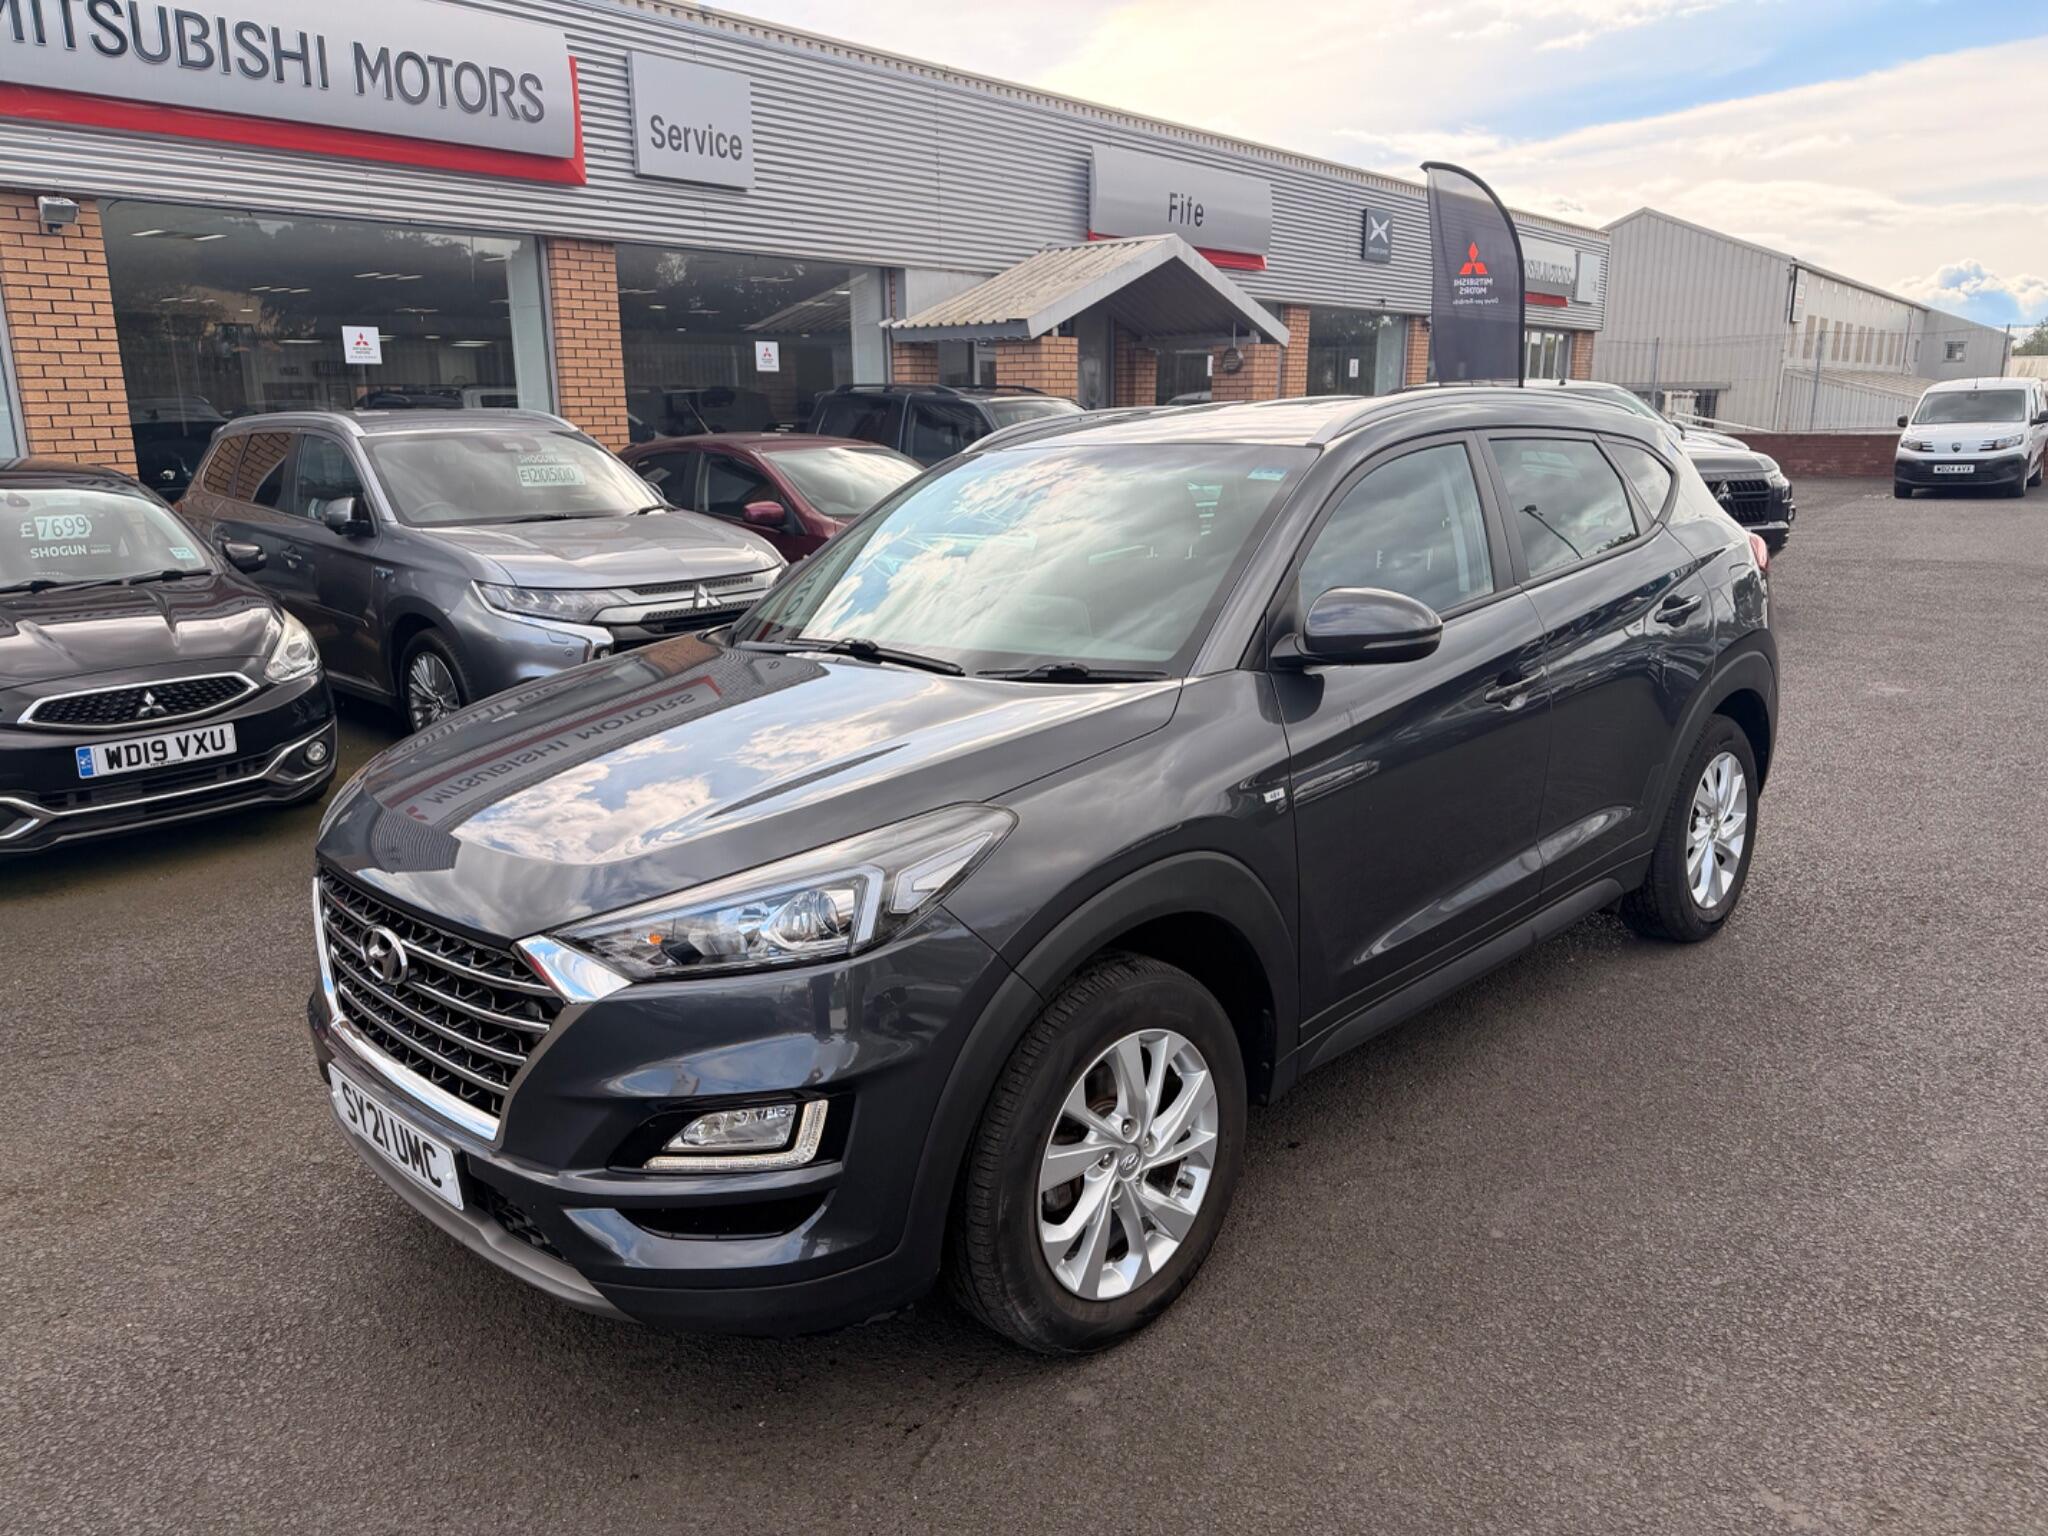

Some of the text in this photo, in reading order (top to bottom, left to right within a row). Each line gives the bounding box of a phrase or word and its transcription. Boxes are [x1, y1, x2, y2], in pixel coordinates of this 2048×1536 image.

[352, 41, 545, 124] MOTORS
[650, 115, 743, 161] Service
[1168, 192, 1204, 227] Fife
[30, 545, 87, 559] SHOGUN
[104, 729, 226, 770] WD19 VXU
[341, 1081, 442, 1189] SY21 UMC
